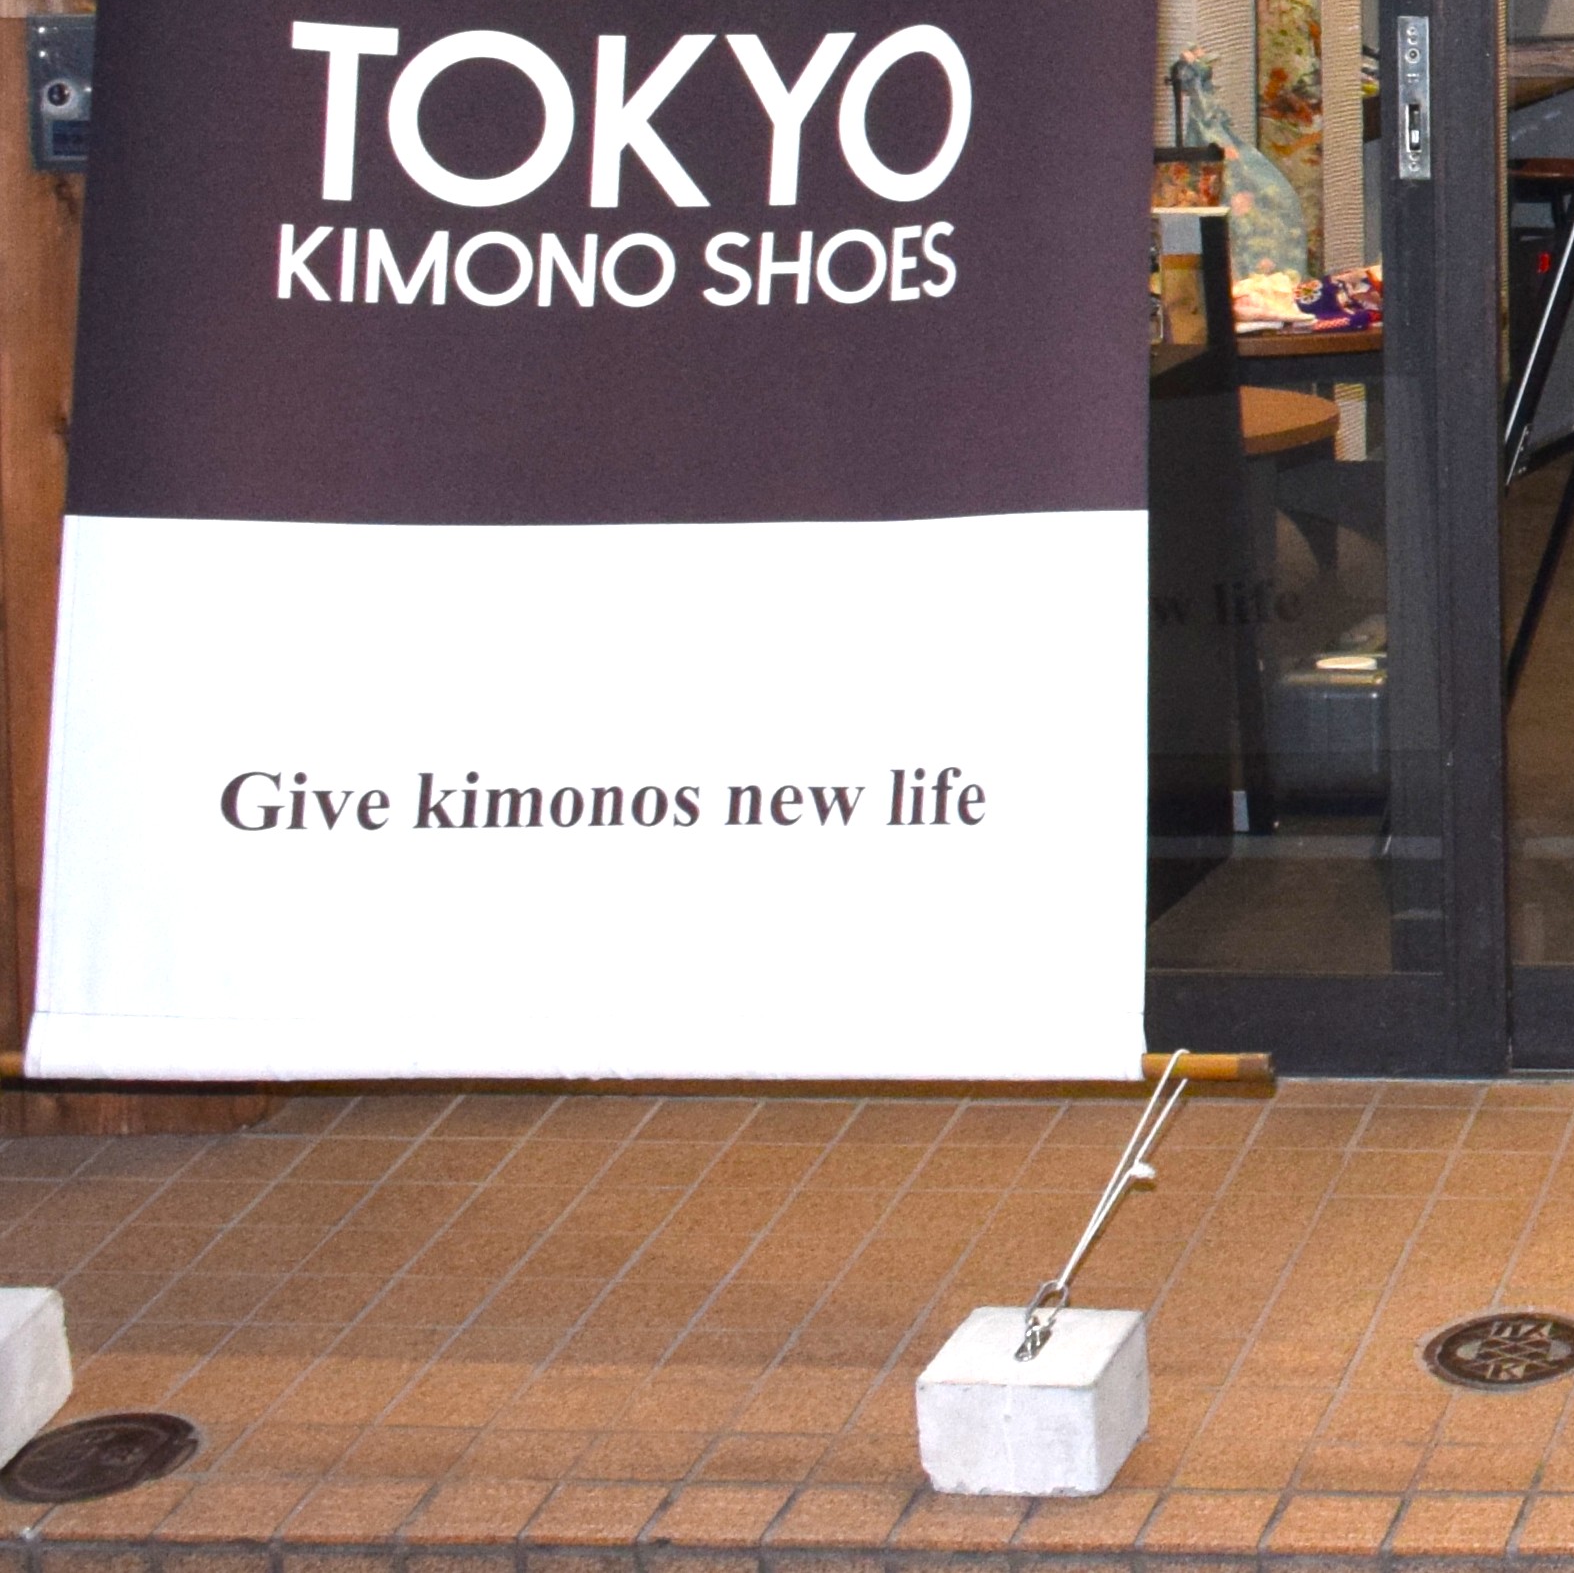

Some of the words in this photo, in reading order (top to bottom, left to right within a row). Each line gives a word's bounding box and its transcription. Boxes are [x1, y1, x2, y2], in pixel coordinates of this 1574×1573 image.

[292, 21, 972, 207] TOKYO
[278, 224, 675, 307] KIMONO
[703, 222, 956, 306] SHOES
[222, 772, 388, 830] Give
[415, 772, 698, 828] kimonos
[727, 786, 865, 825] new
[889, 768, 985, 825] life
